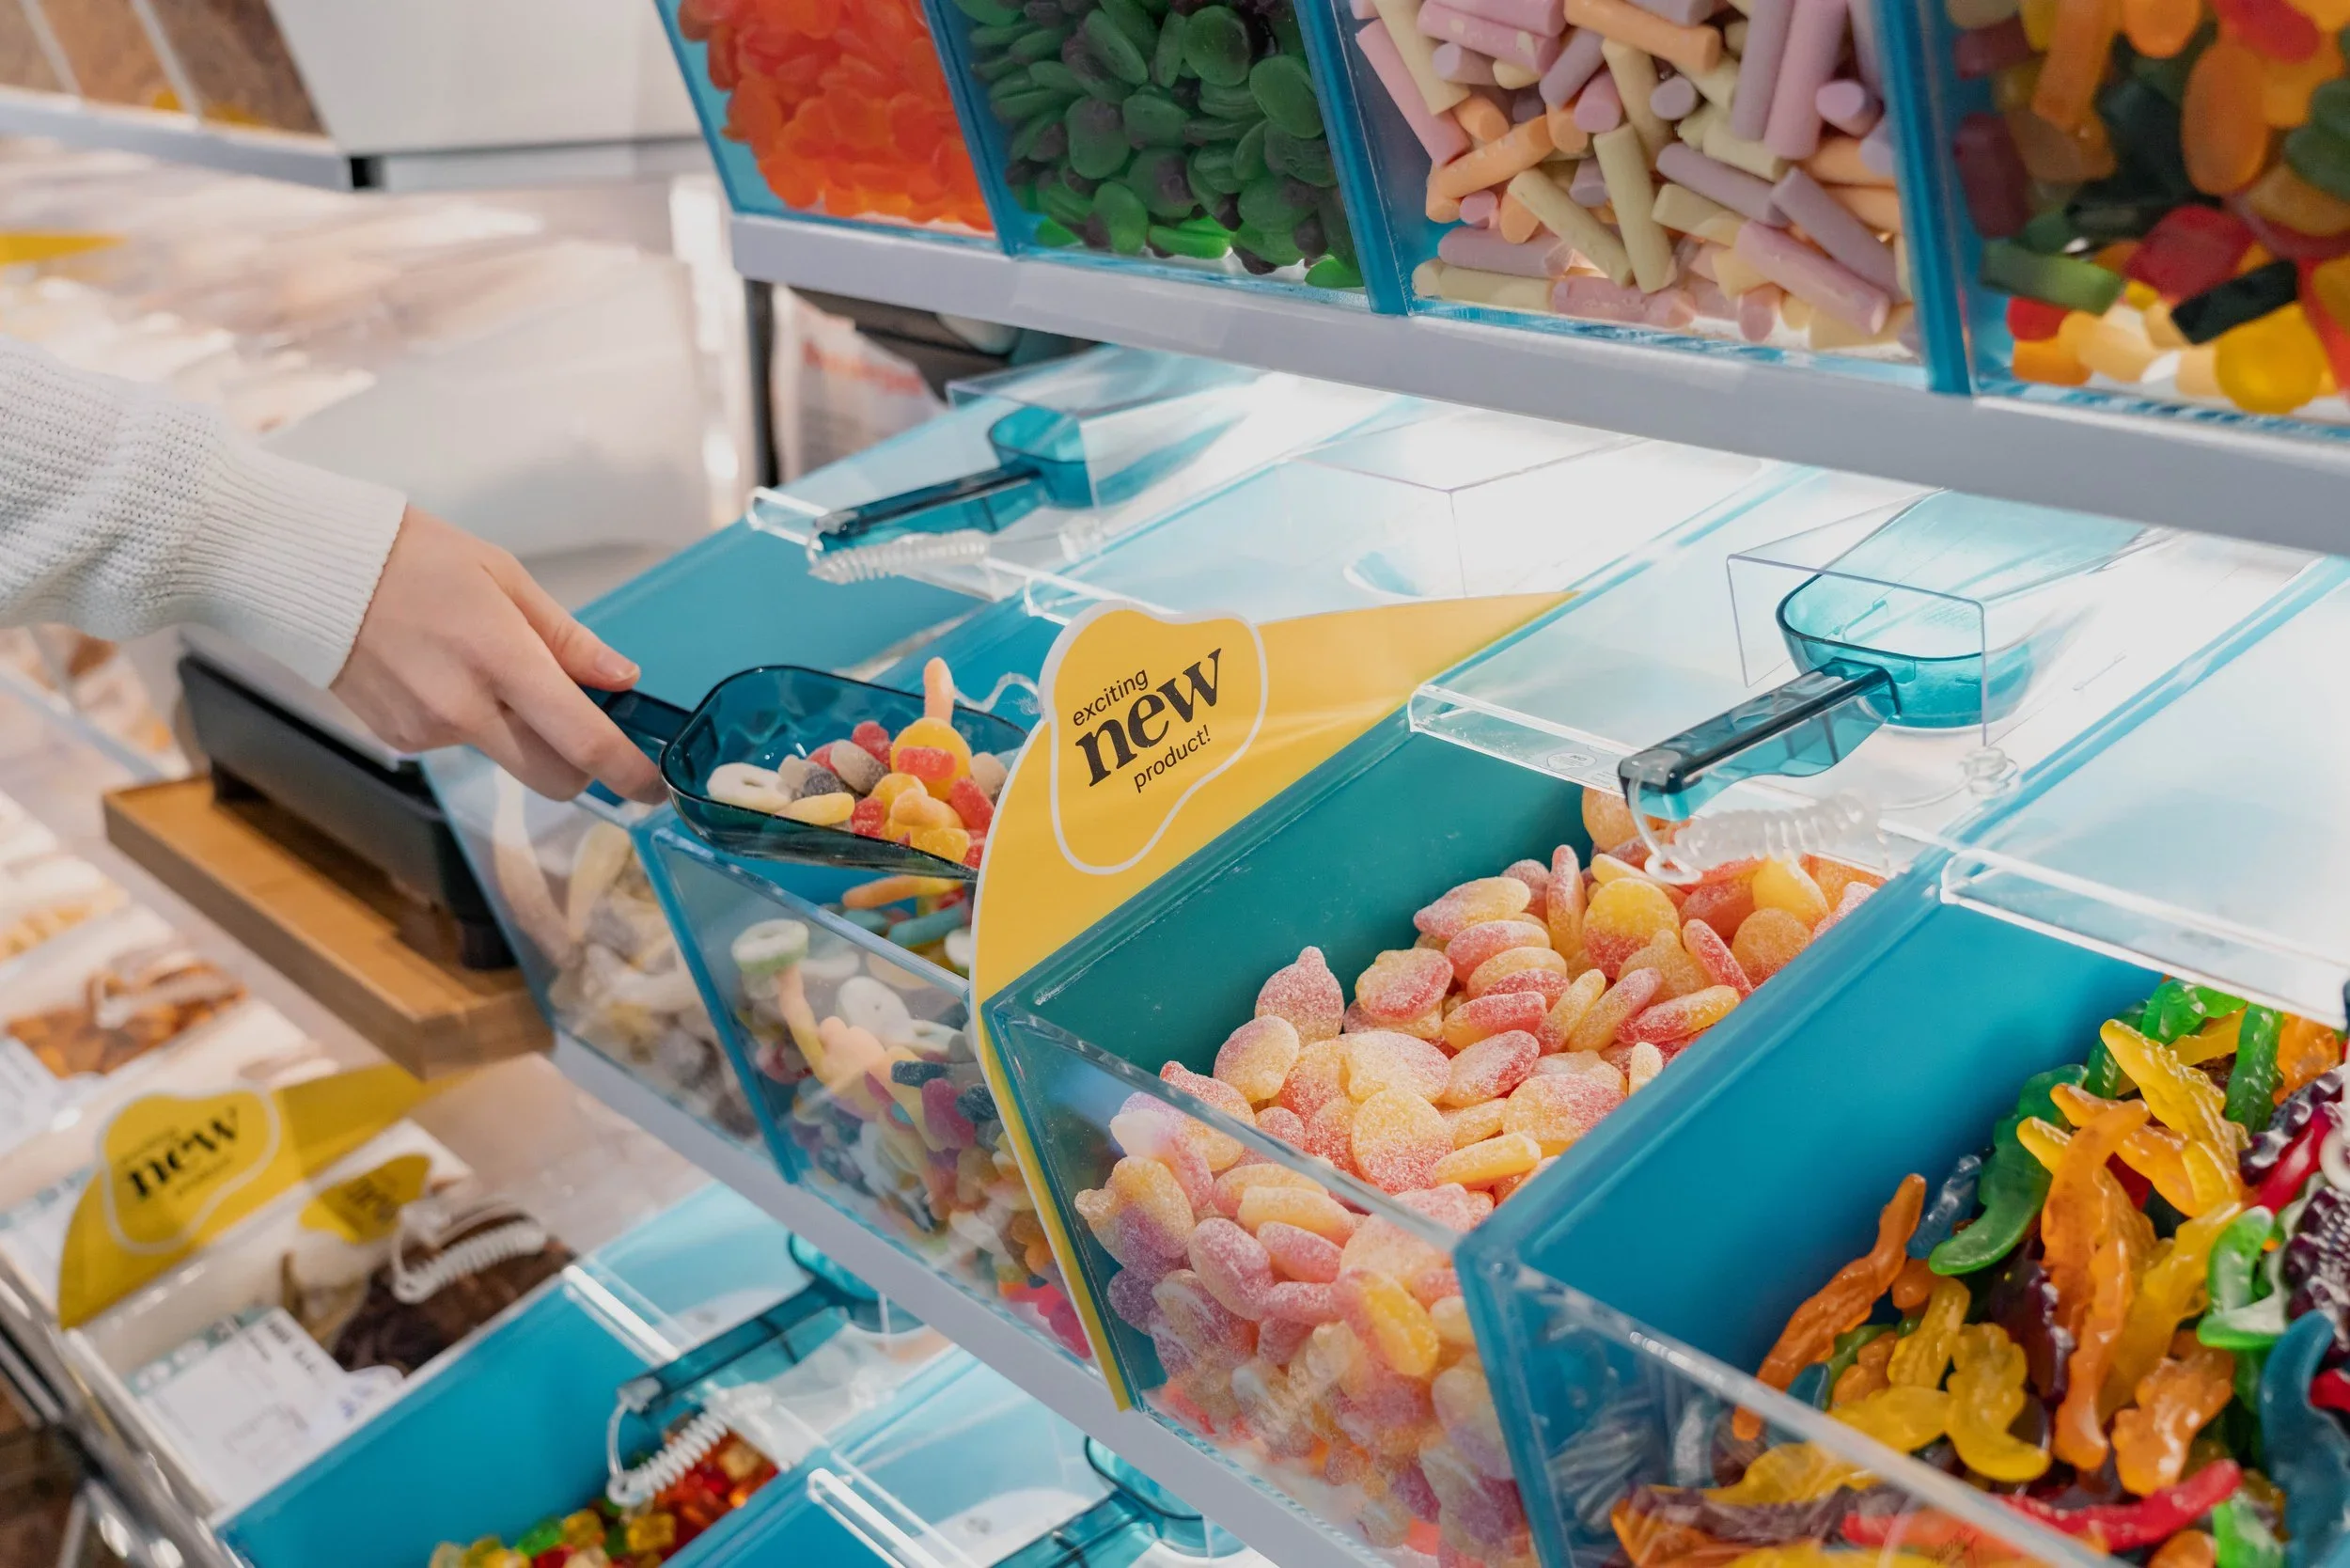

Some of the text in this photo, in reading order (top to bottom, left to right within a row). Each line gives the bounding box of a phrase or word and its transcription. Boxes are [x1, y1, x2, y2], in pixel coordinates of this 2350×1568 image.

[1073, 669, 1149, 727] exciting
[1075, 648, 1222, 787] new
[1133, 724, 1212, 792] product!
[129, 1107, 239, 1201] new
